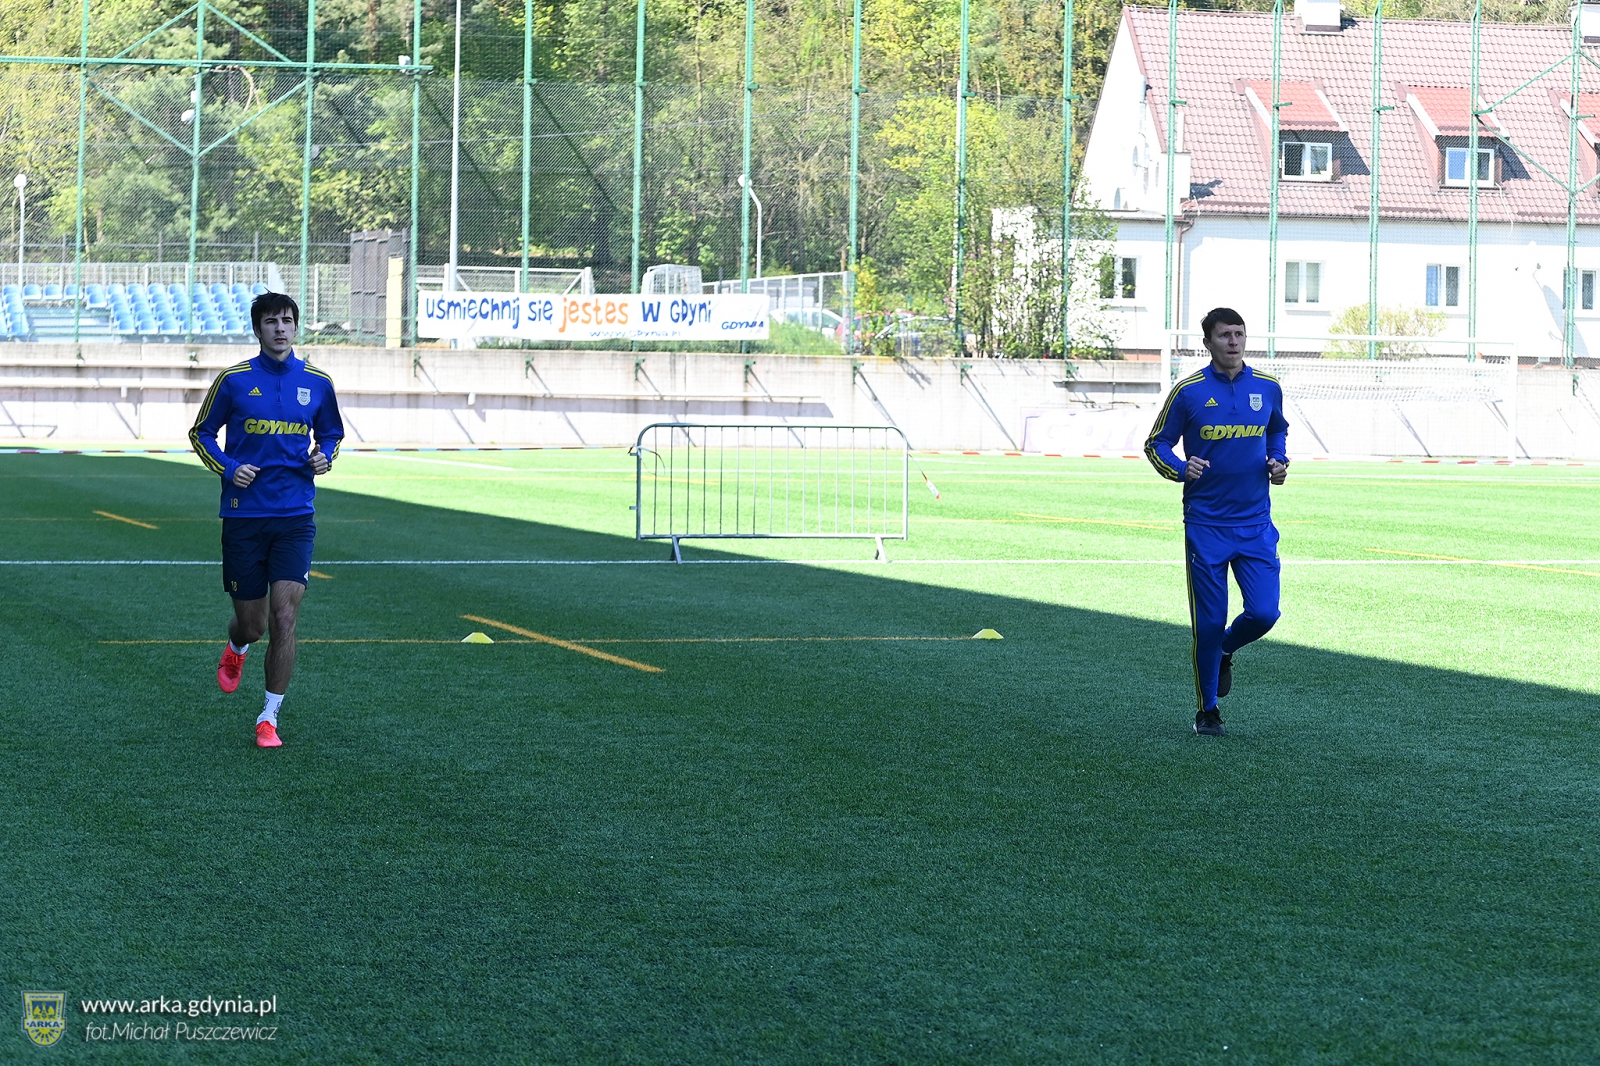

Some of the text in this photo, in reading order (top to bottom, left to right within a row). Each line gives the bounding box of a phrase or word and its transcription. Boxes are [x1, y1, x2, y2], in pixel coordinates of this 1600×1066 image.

[244, 418, 309, 436] GDYNIA
[1200, 424, 1266, 441] GDYNIA
[230, 497, 239, 509] 18
